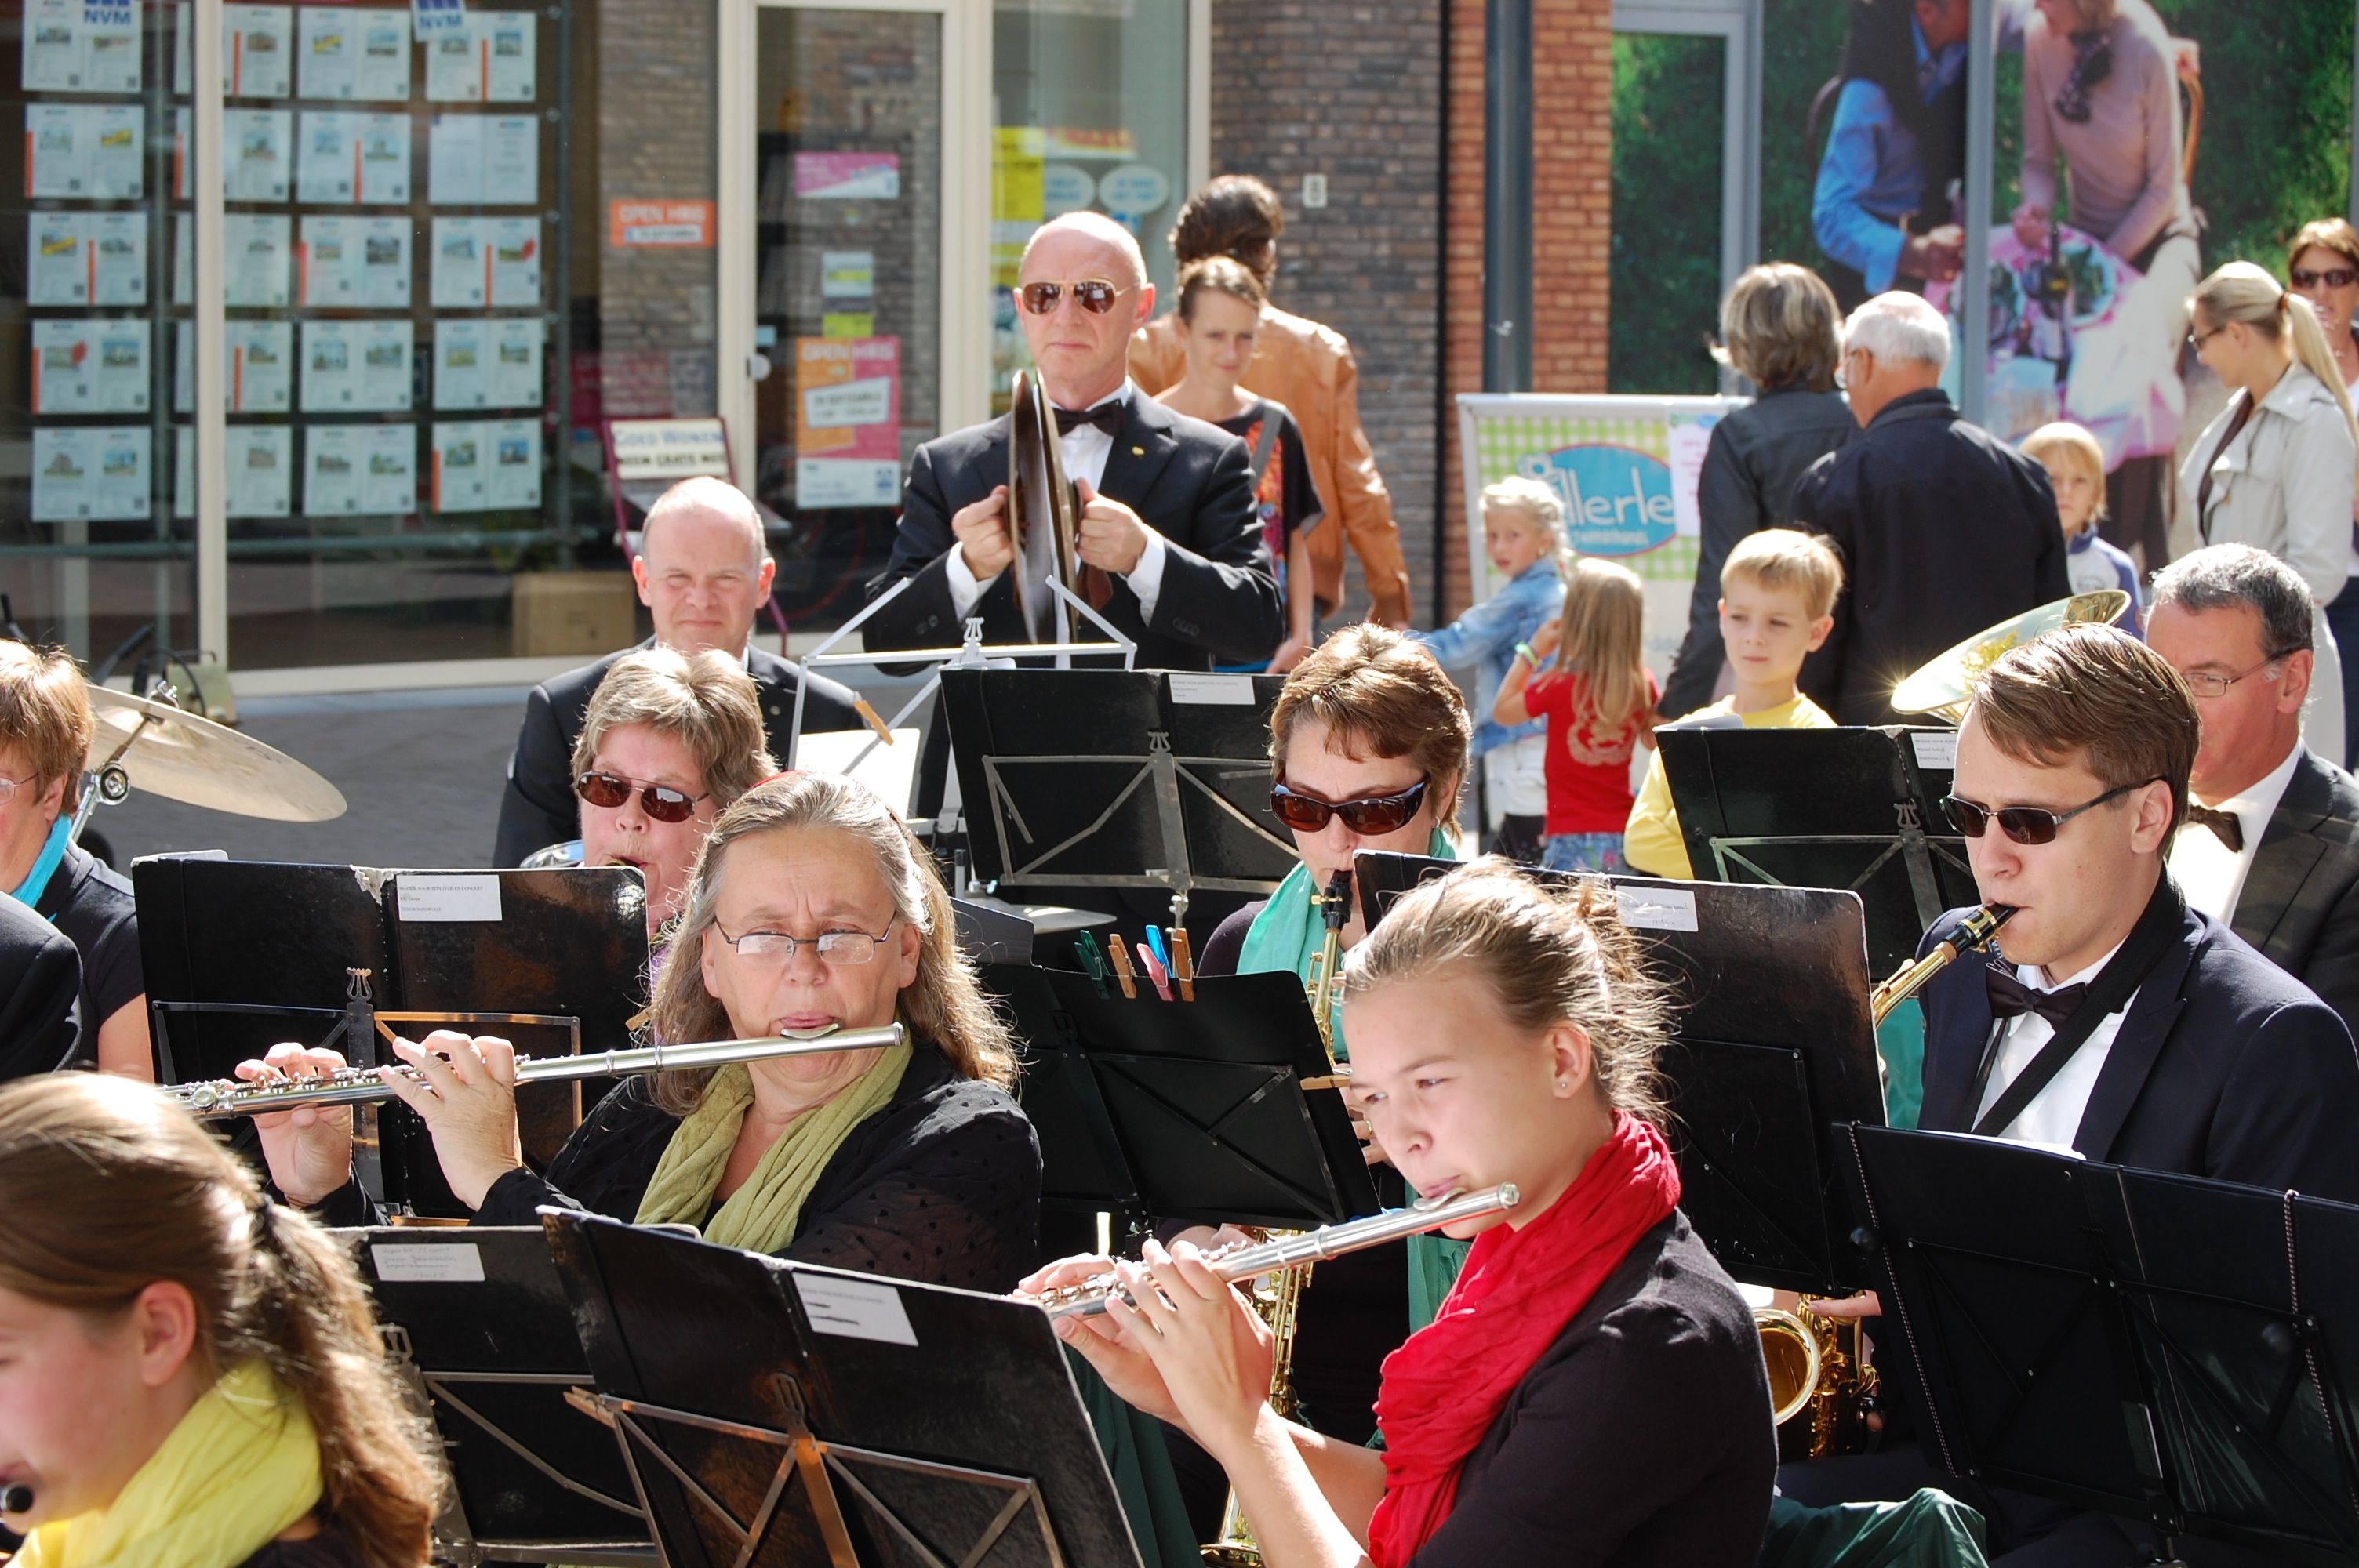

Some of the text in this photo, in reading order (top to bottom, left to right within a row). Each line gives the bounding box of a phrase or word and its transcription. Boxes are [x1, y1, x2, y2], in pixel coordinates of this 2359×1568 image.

[84, 9, 131, 24] NVM
[420, 15, 463, 29] NVM
[618, 205, 663, 223] OPEN
[801, 343, 849, 361] OPEN
